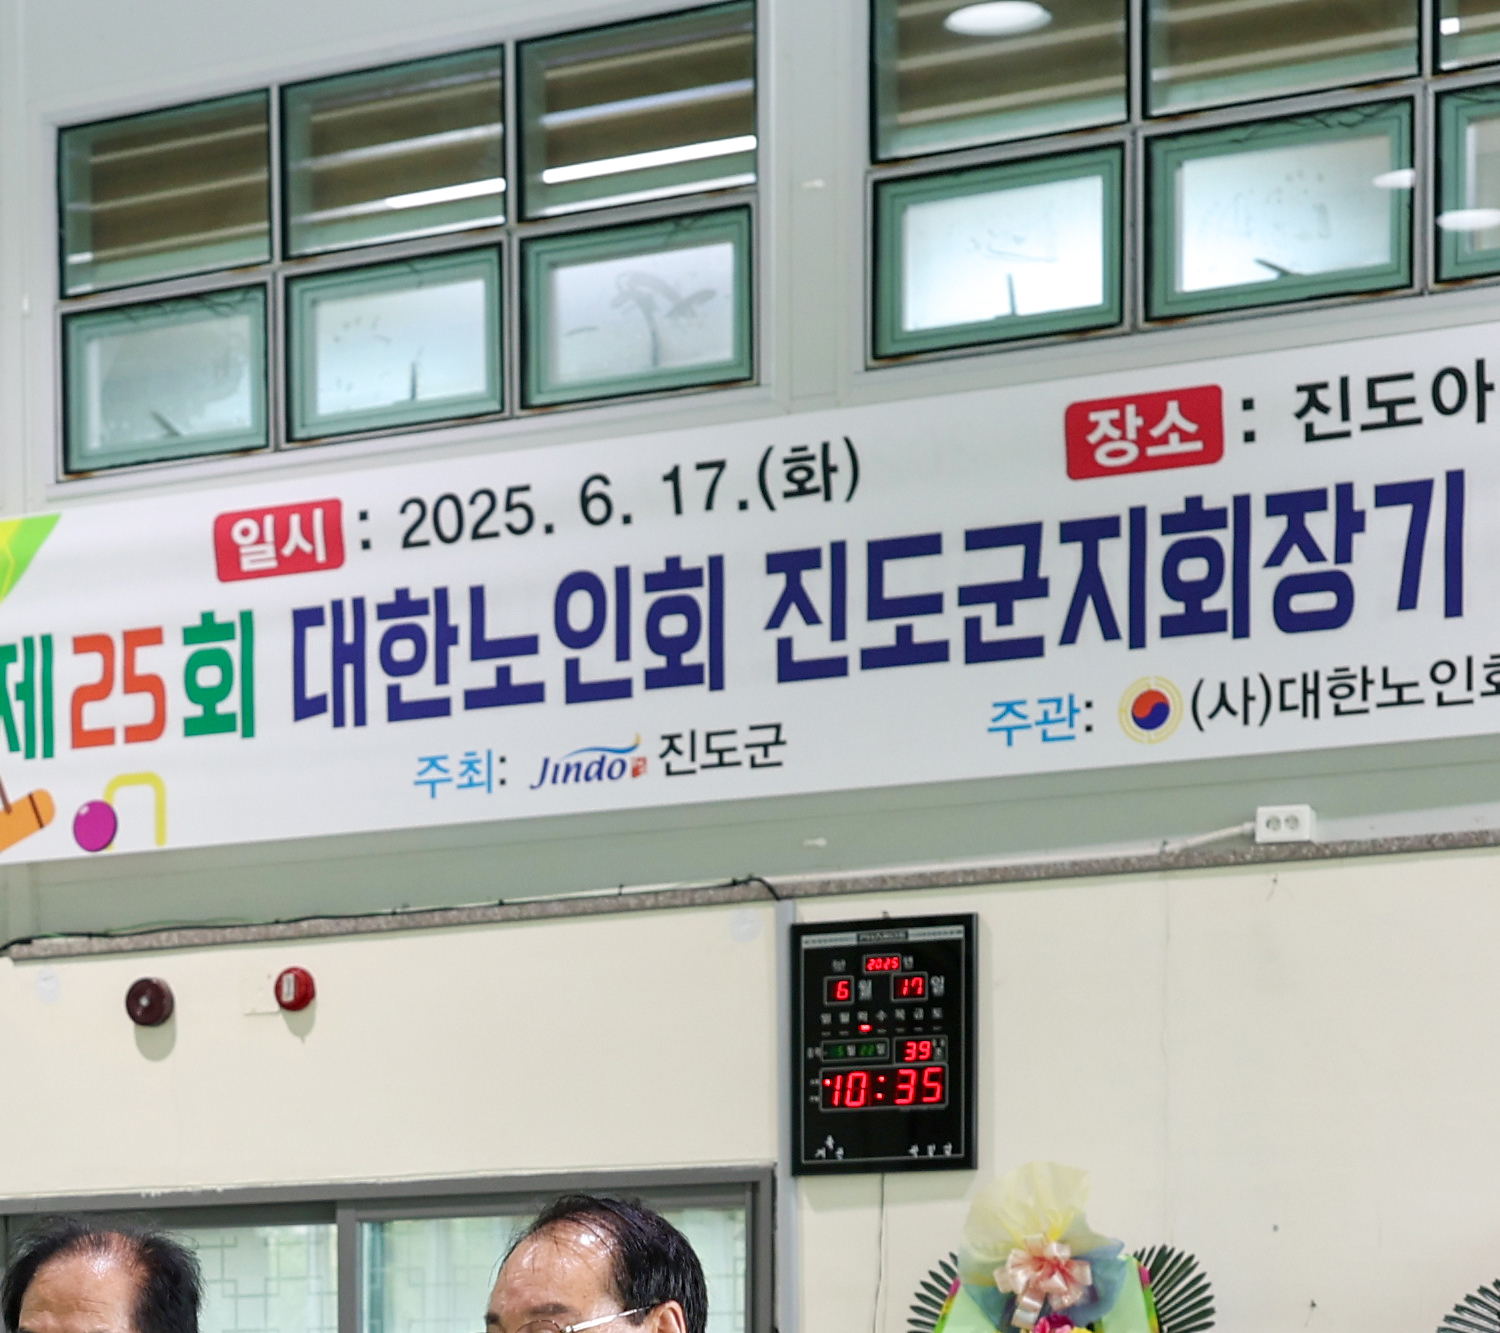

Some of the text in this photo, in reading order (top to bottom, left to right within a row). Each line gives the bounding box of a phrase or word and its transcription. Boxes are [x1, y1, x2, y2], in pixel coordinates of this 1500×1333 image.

[1083, 401, 1205, 468] 장소
[229, 511, 328, 575] 일시
[399, 483, 555, 550] 2025.
[579, 473, 633, 527] 6.
[661, 436, 860, 517] 17.(화)
[290, 554, 726, 731] 대한노인회
[763, 468, 1467, 684] 진도군지회장기
[986, 694, 1095, 748] 주관:
[413, 722, 788, 799] 주최: Jindo 진도군
[835, 980, 850, 1001] 6
[901, 976, 925, 997] 17
[866, 956, 900, 971] 2025
[903, 1040, 933, 1062] 39
[832, 1067, 943, 1108] 10:35
